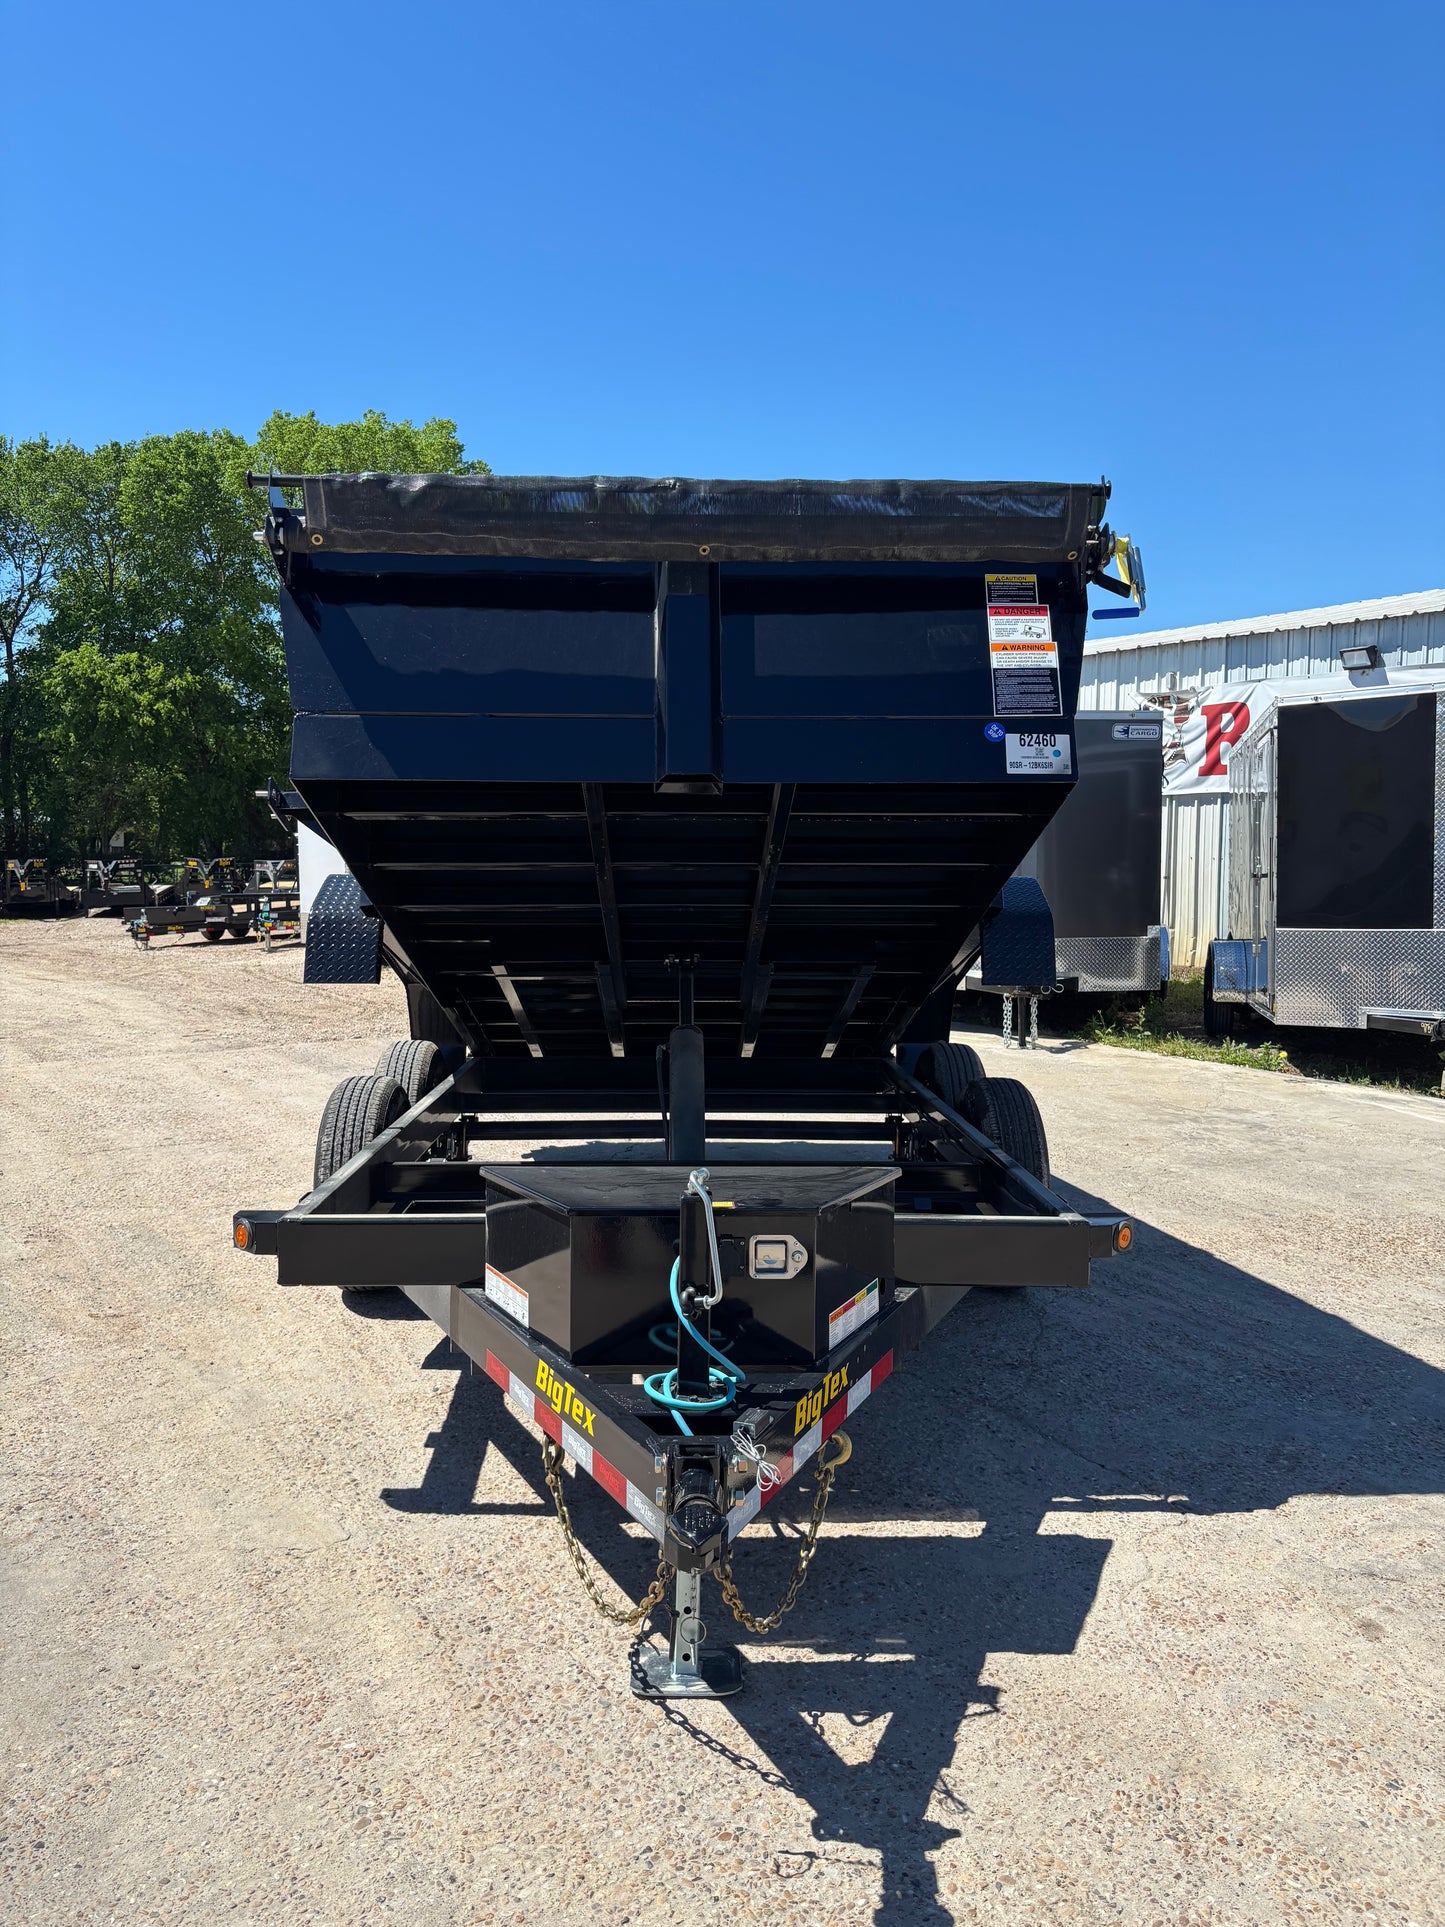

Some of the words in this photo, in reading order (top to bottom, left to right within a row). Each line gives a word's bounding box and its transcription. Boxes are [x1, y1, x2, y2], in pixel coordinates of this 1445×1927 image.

[1004, 607, 1041, 615] DANGER
[1019, 734, 1057, 748] 62460
[536, 1359, 597, 1437] BigTex
[793, 1362, 849, 1437] BigTex
[634, 1495, 657, 1523] BigTex
